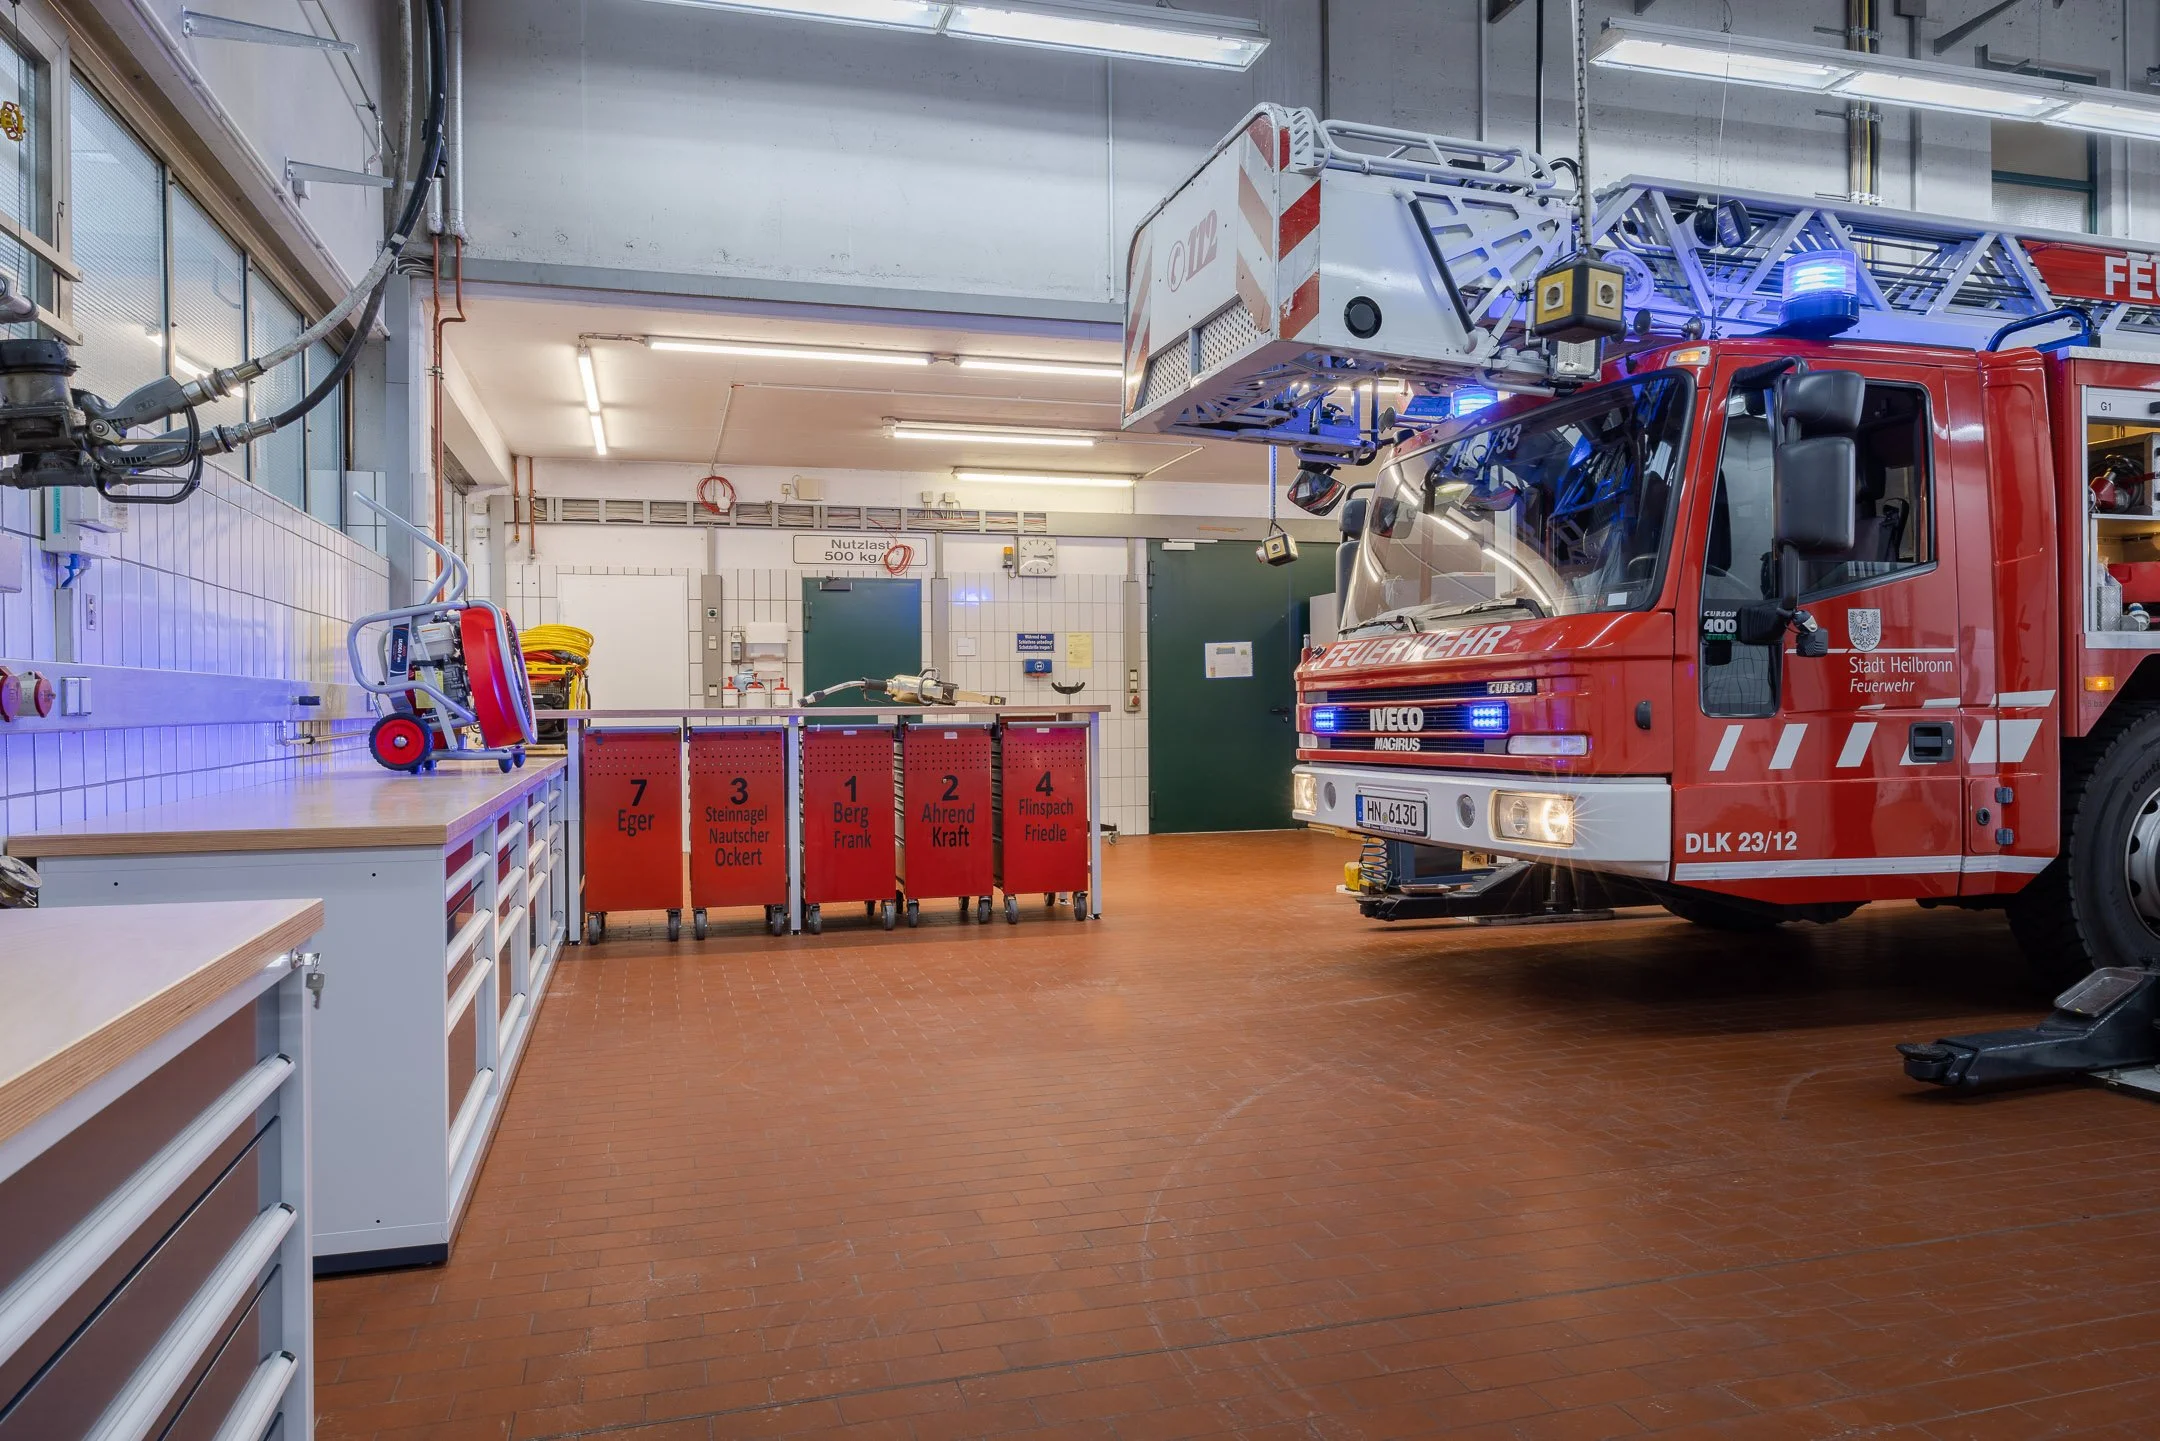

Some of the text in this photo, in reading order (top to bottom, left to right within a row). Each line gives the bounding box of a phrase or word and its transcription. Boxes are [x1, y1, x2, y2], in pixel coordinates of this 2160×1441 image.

[1186, 209, 1217, 281] 112
[2105, 256, 2160, 301] FE
[2100, 401, 2112, 411] G1
[831, 539, 891, 550] Nutzlast
[824, 551, 854, 561] 500
[1703, 618, 1738, 633] 400
[1319, 625, 1511, 669] FEUERWEHR
[1849, 656, 1953, 674] Stadt Heilbronn
[1487, 681, 1533, 694] CURSOR
[1849, 678, 1915, 693] Feuerwehr
[1369, 706, 1424, 732] IVECO
[1374, 737, 1421, 752] MAGIRUS
[630, 779, 648, 807] 7
[730, 777, 749, 805] 3
[844, 775, 857, 803] 1
[941, 774, 960, 801] 2
[1035, 771, 1054, 797] 4
[705, 805, 768, 825] Steinnagel
[833, 802, 869, 829] Berg
[921, 802, 975, 824] Ahrend
[1018, 798, 1074, 819] Flinspach
[1367, 800, 1382, 822] HN
[1388, 802, 1417, 826] 6130
[618, 808, 655, 837] Eger
[1025, 823, 1067, 842] Friedle
[709, 827, 770, 844] Nautscher
[833, 829, 872, 849] Frank
[932, 824, 970, 848] Kraft
[1685, 831, 1798, 854] DLK 23/12
[714, 847, 763, 867] Ockert
